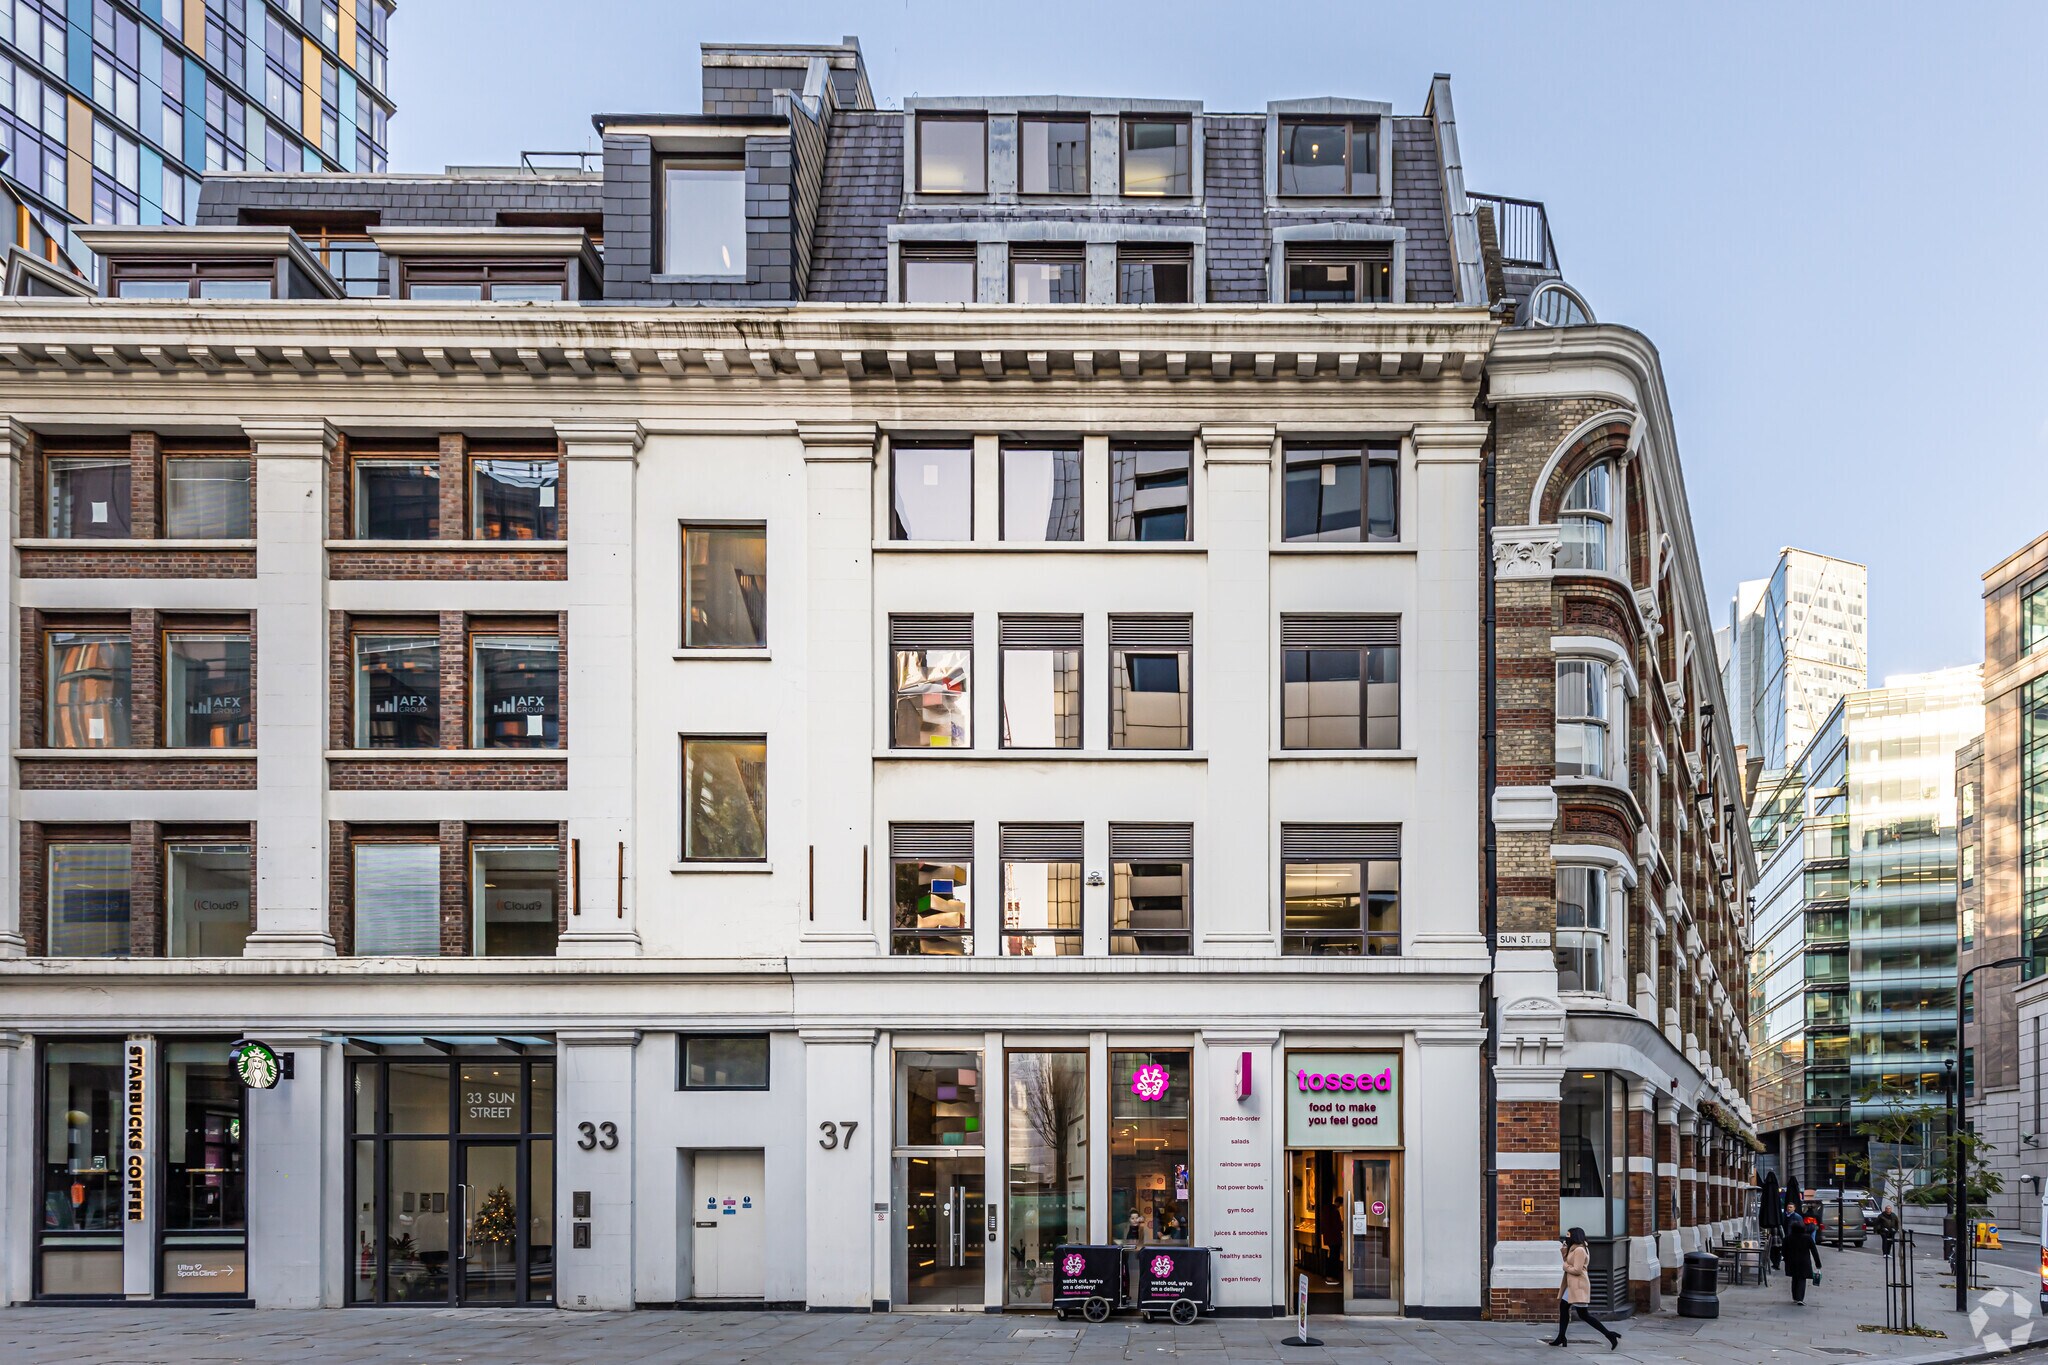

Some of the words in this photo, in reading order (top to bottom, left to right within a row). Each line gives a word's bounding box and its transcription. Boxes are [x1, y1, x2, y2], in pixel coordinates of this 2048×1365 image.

[213, 697, 241, 707] AFX
[399, 696, 427, 706] AFX
[516, 696, 545, 706] AFX
[201, 900, 239, 910] Cloud9
[504, 900, 542, 910] Cloud9
[1500, 935, 1517, 944] SUN
[1297, 1067, 1392, 1091] tossed
[129, 1045, 143, 1150] STARBUCKS
[467, 1092, 482, 1104] 33
[488, 1092, 515, 1104] SUN
[470, 1107, 512, 1118] STREET
[1309, 1102, 1333, 1112] food
[1335, 1103, 1346, 1112] to
[1349, 1102, 1377, 1112] make
[1308, 1117, 1327, 1127] you
[1330, 1116, 1349, 1125] feel
[1352, 1116, 1378, 1127] good
[577, 1121, 619, 1150] 33
[819, 1121, 858, 1150] 37
[128, 1155, 142, 1220] COFFEE
[1523, 1200, 1533, 1212] H
[177, 1270, 198, 1278] Sports
